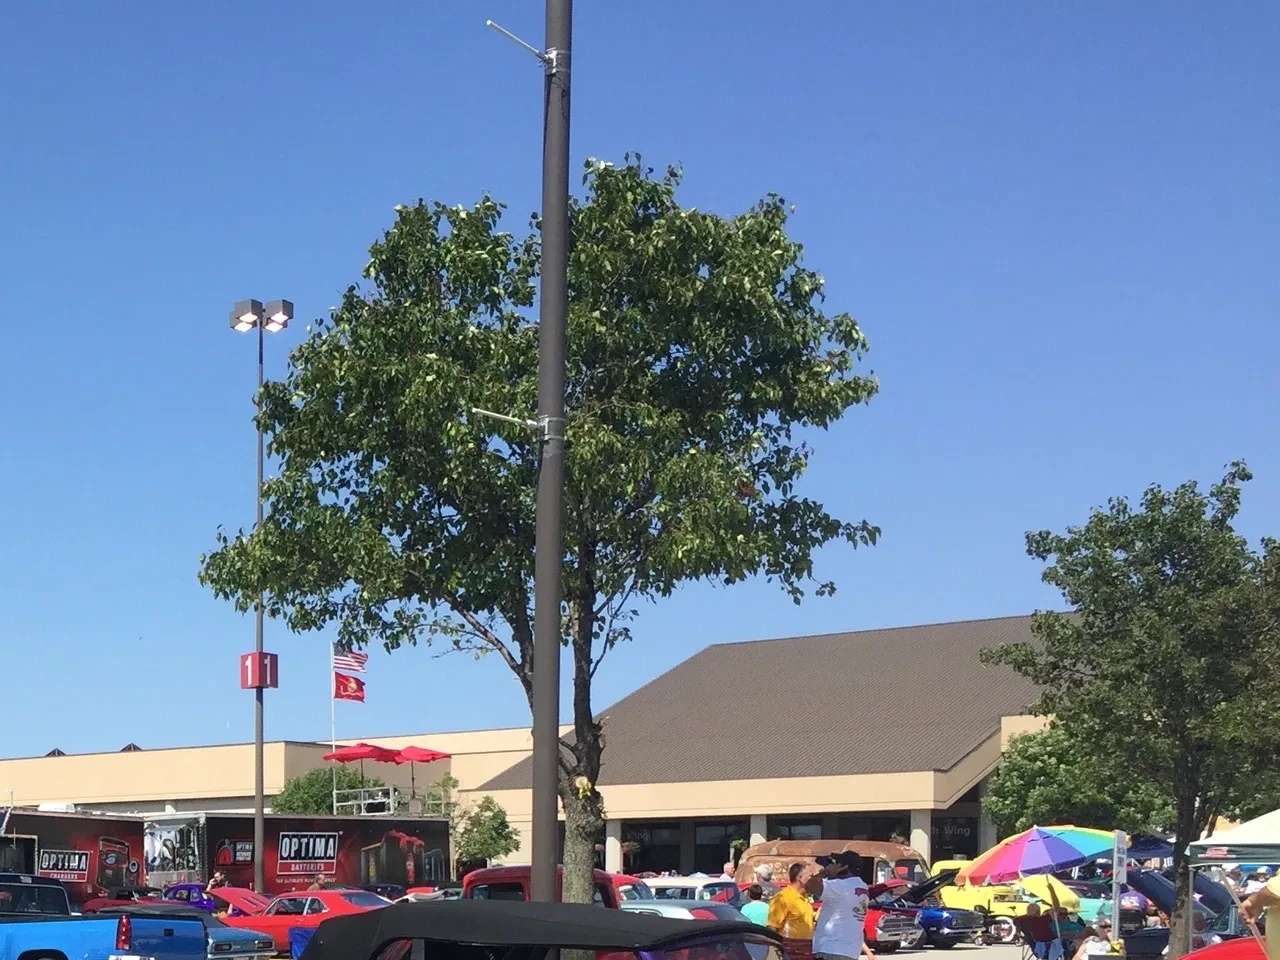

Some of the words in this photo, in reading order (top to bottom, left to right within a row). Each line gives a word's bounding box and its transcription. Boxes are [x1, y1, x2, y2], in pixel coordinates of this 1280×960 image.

[281, 837, 335, 858] OPTIMA
[41, 852, 87, 870] OPTIMA
[291, 863, 325, 872] BATTERIES
